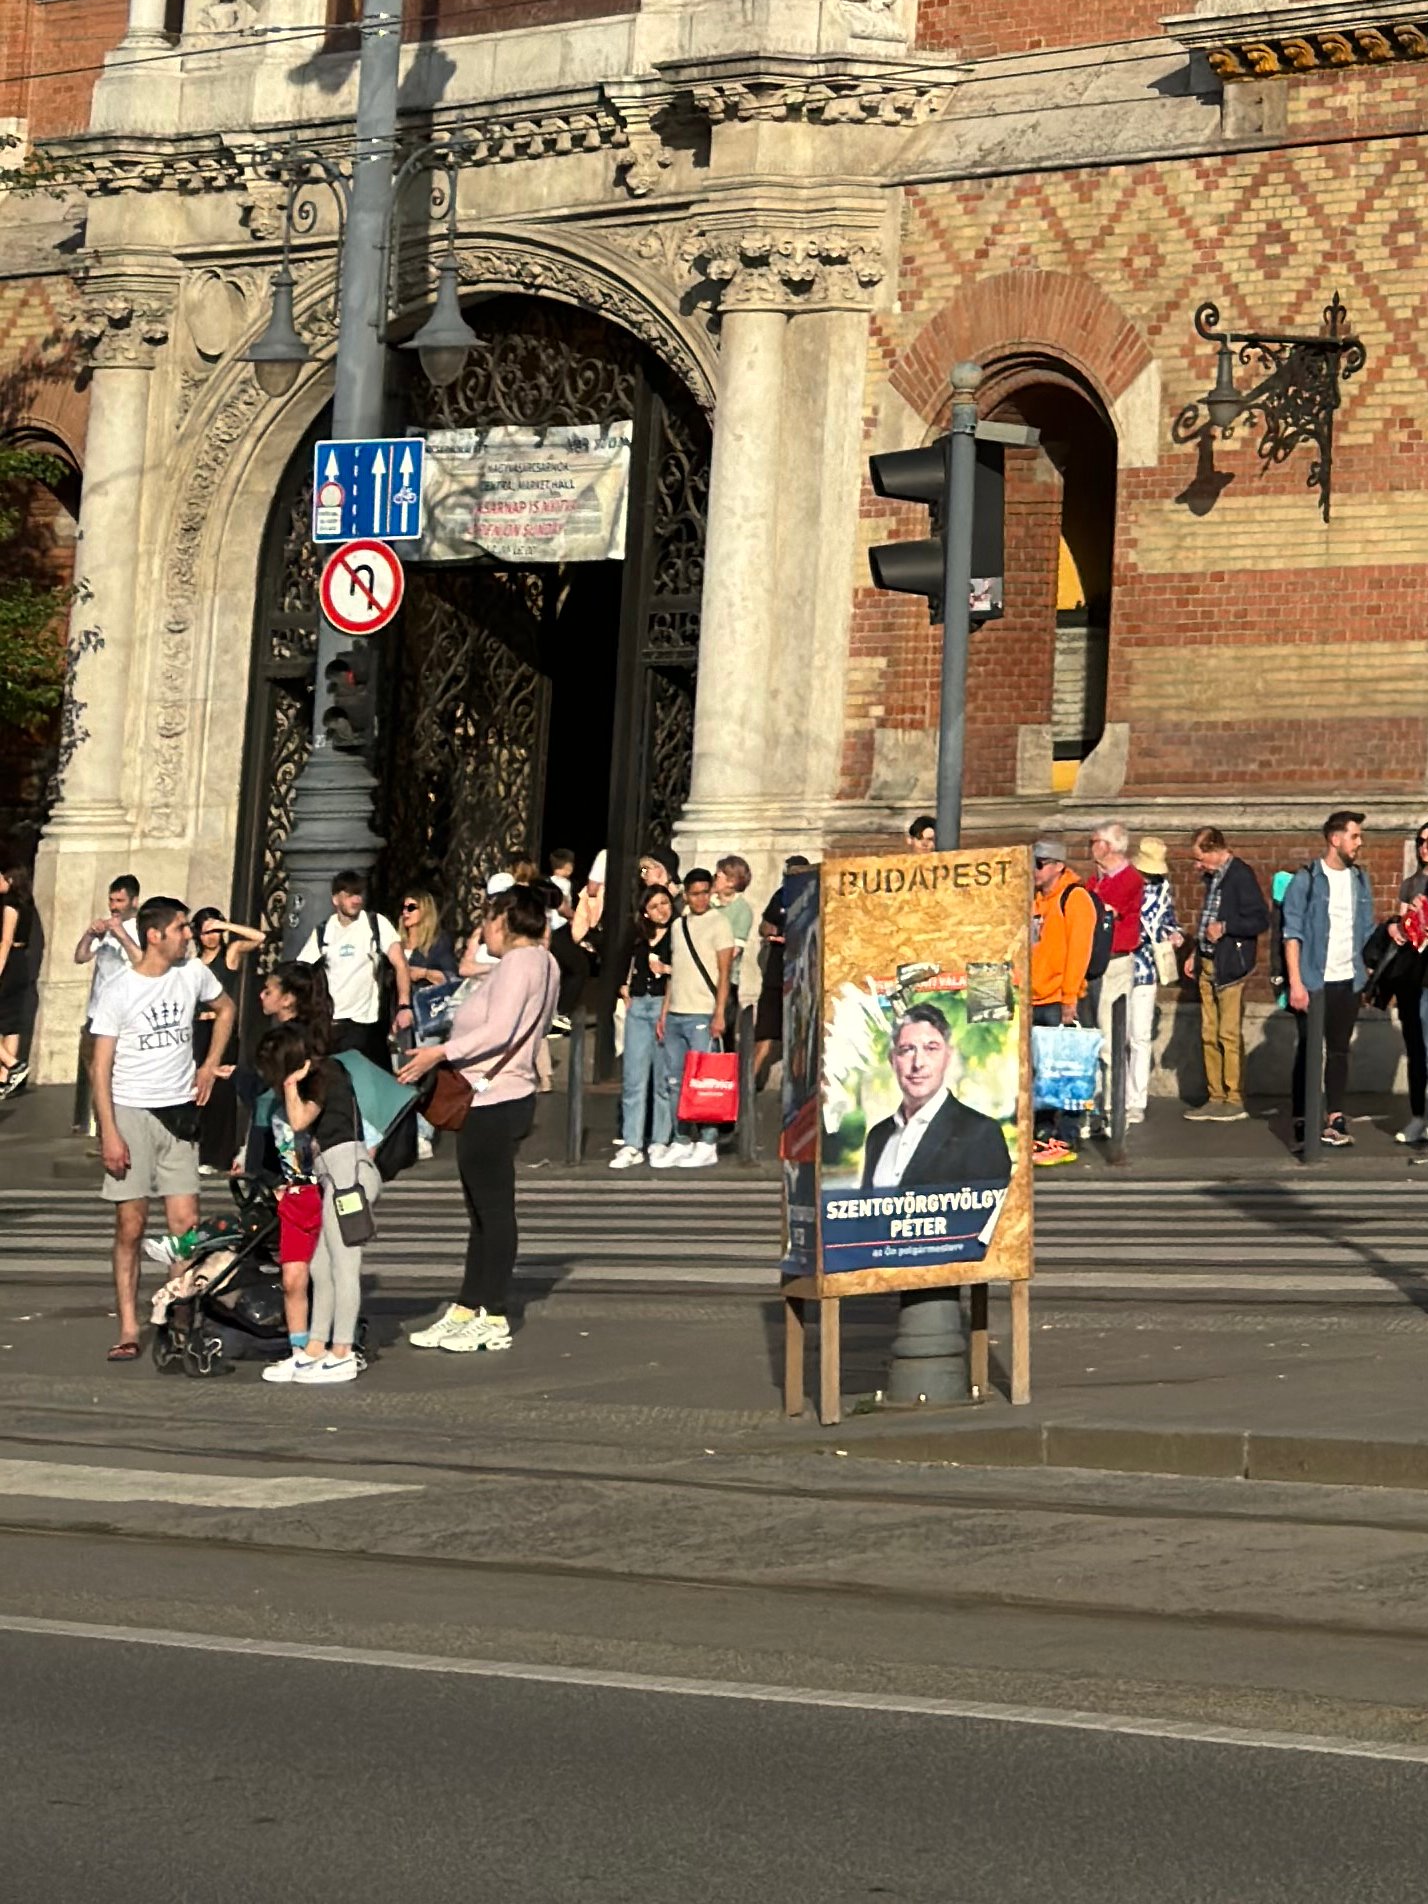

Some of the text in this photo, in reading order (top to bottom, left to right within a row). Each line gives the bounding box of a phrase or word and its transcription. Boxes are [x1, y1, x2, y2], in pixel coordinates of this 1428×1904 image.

[838, 859, 1013, 897] BUDAPEST
[137, 1026, 191, 1051] KING
[826, 1187, 1007, 1220] SZENTGYÖRGYVÖLGY
[890, 1213, 947, 1239] PÉTER
